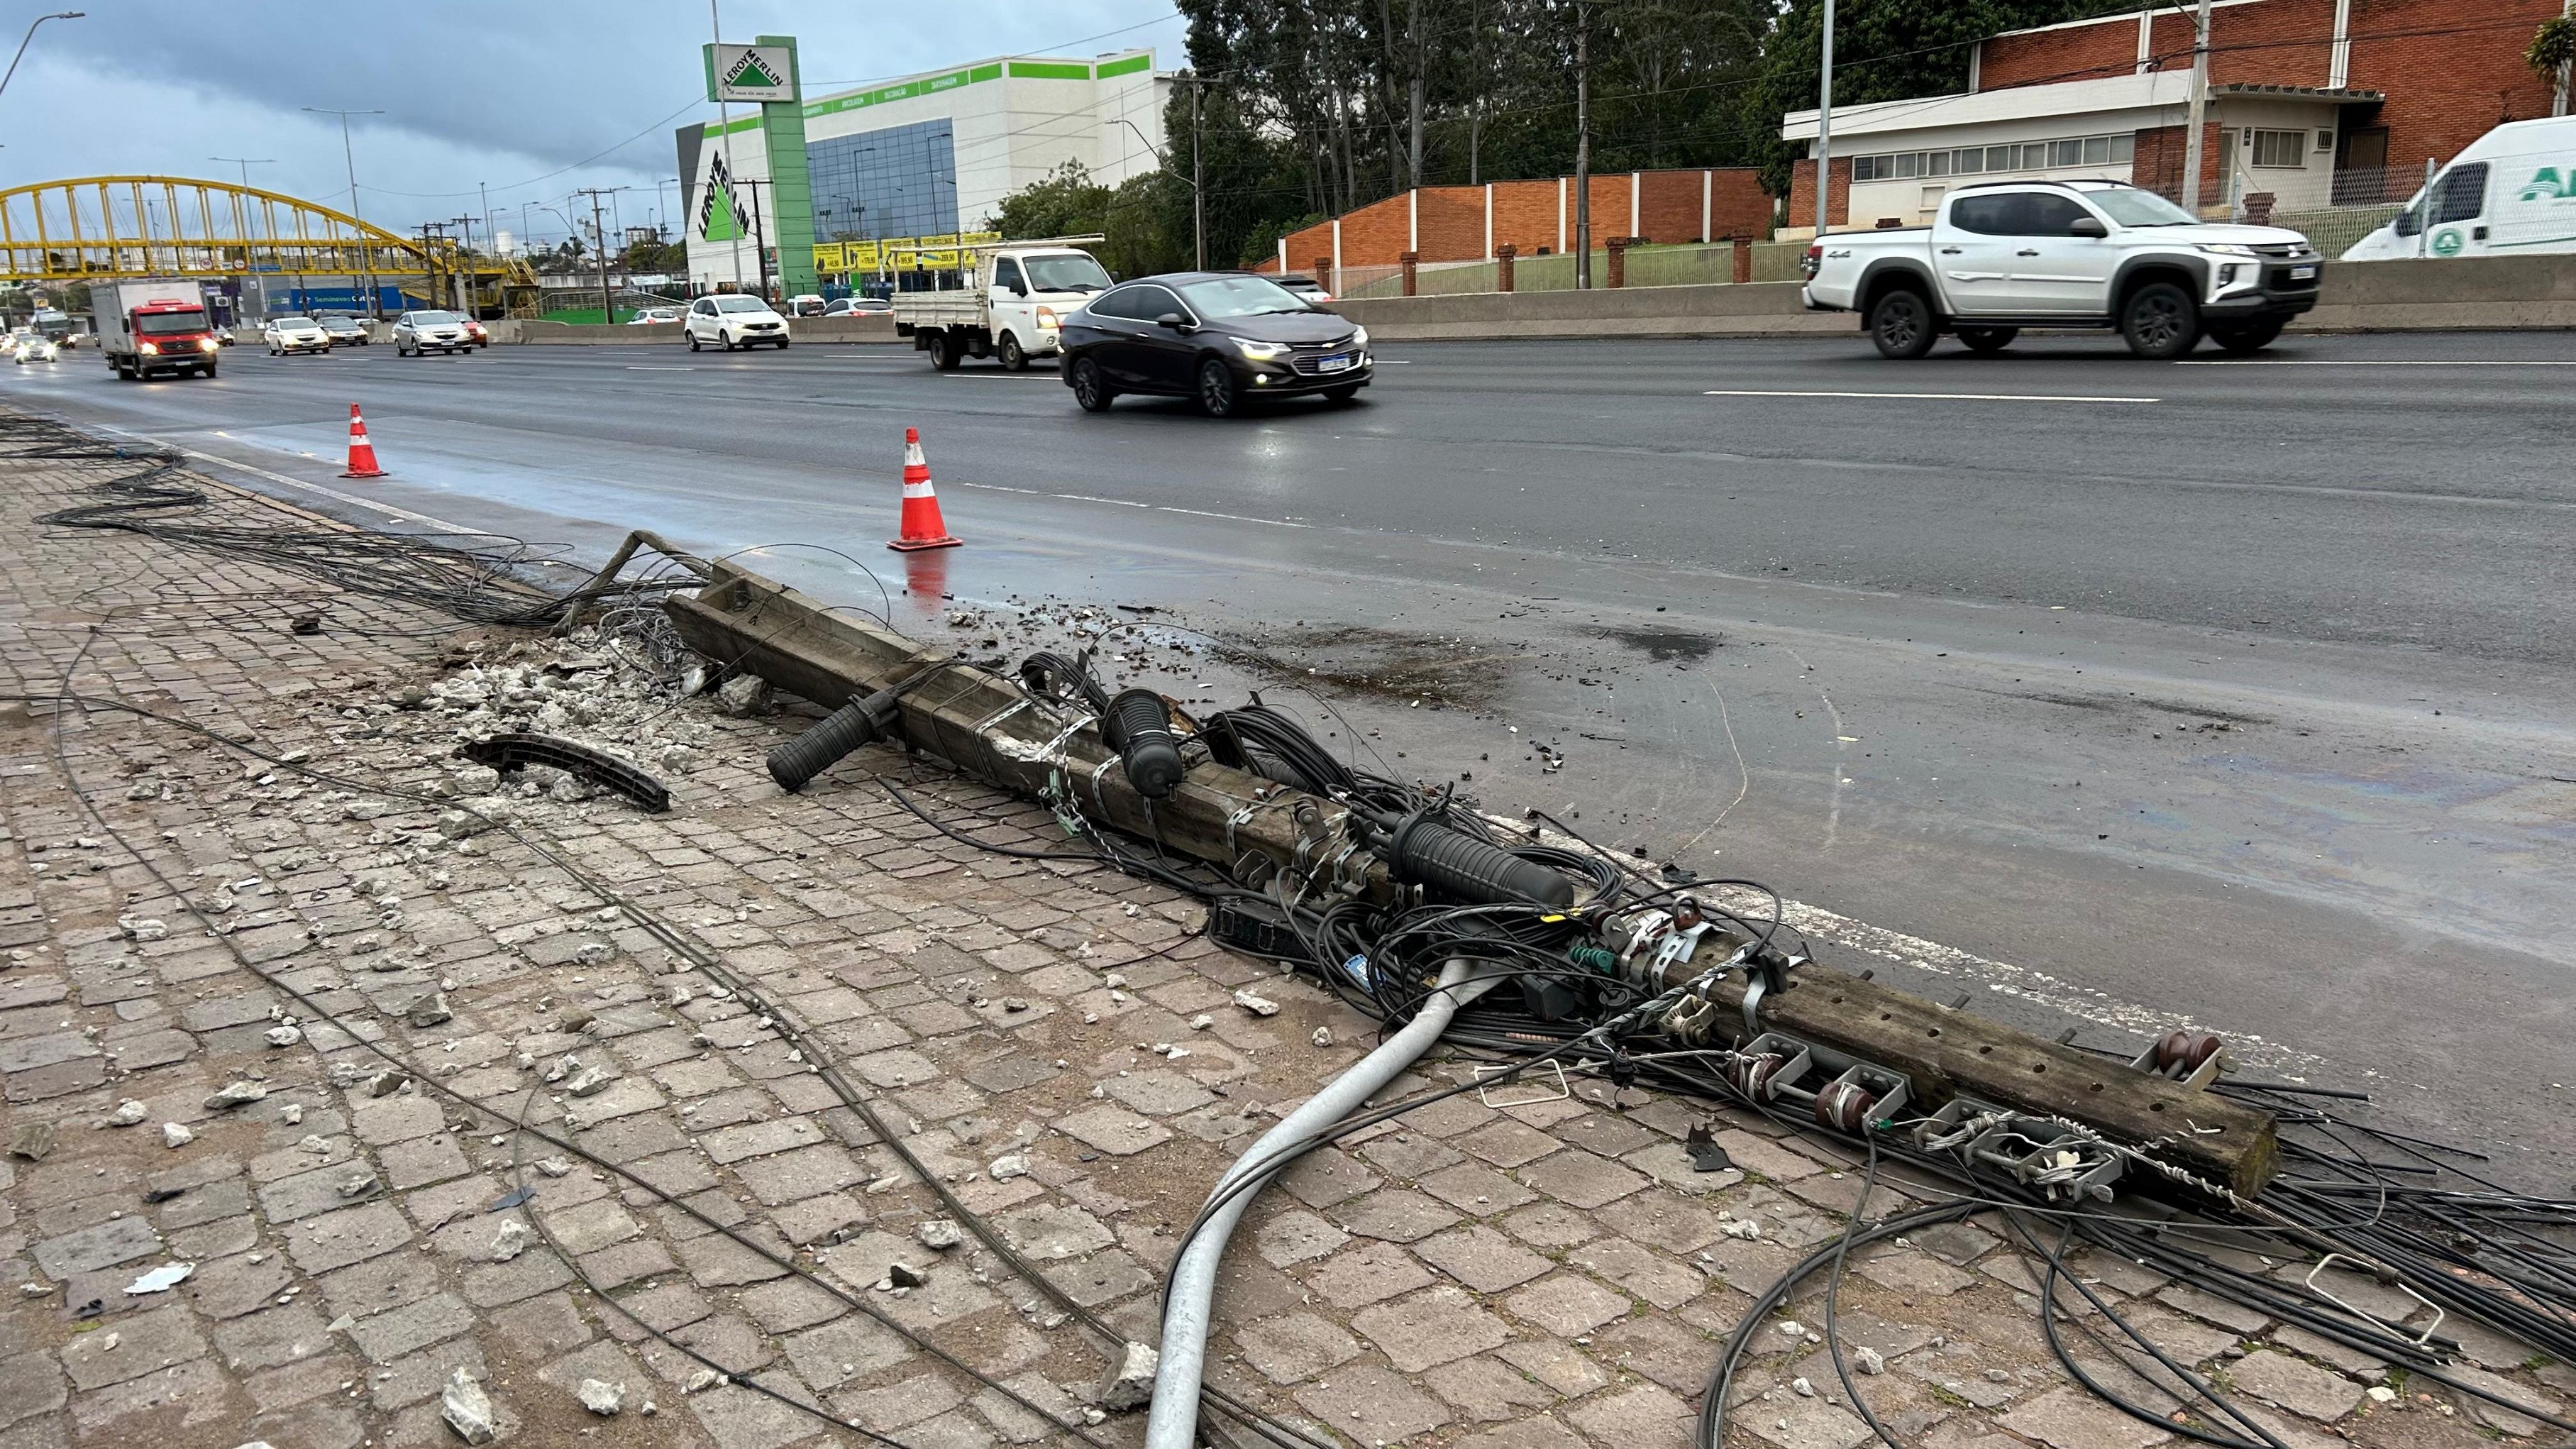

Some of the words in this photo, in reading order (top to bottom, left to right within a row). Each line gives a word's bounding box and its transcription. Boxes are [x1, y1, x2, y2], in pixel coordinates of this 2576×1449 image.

[722, 55, 749, 85] LEROY
[745, 48, 784, 87] MERLIN
[698, 166, 718, 240] LEROY
